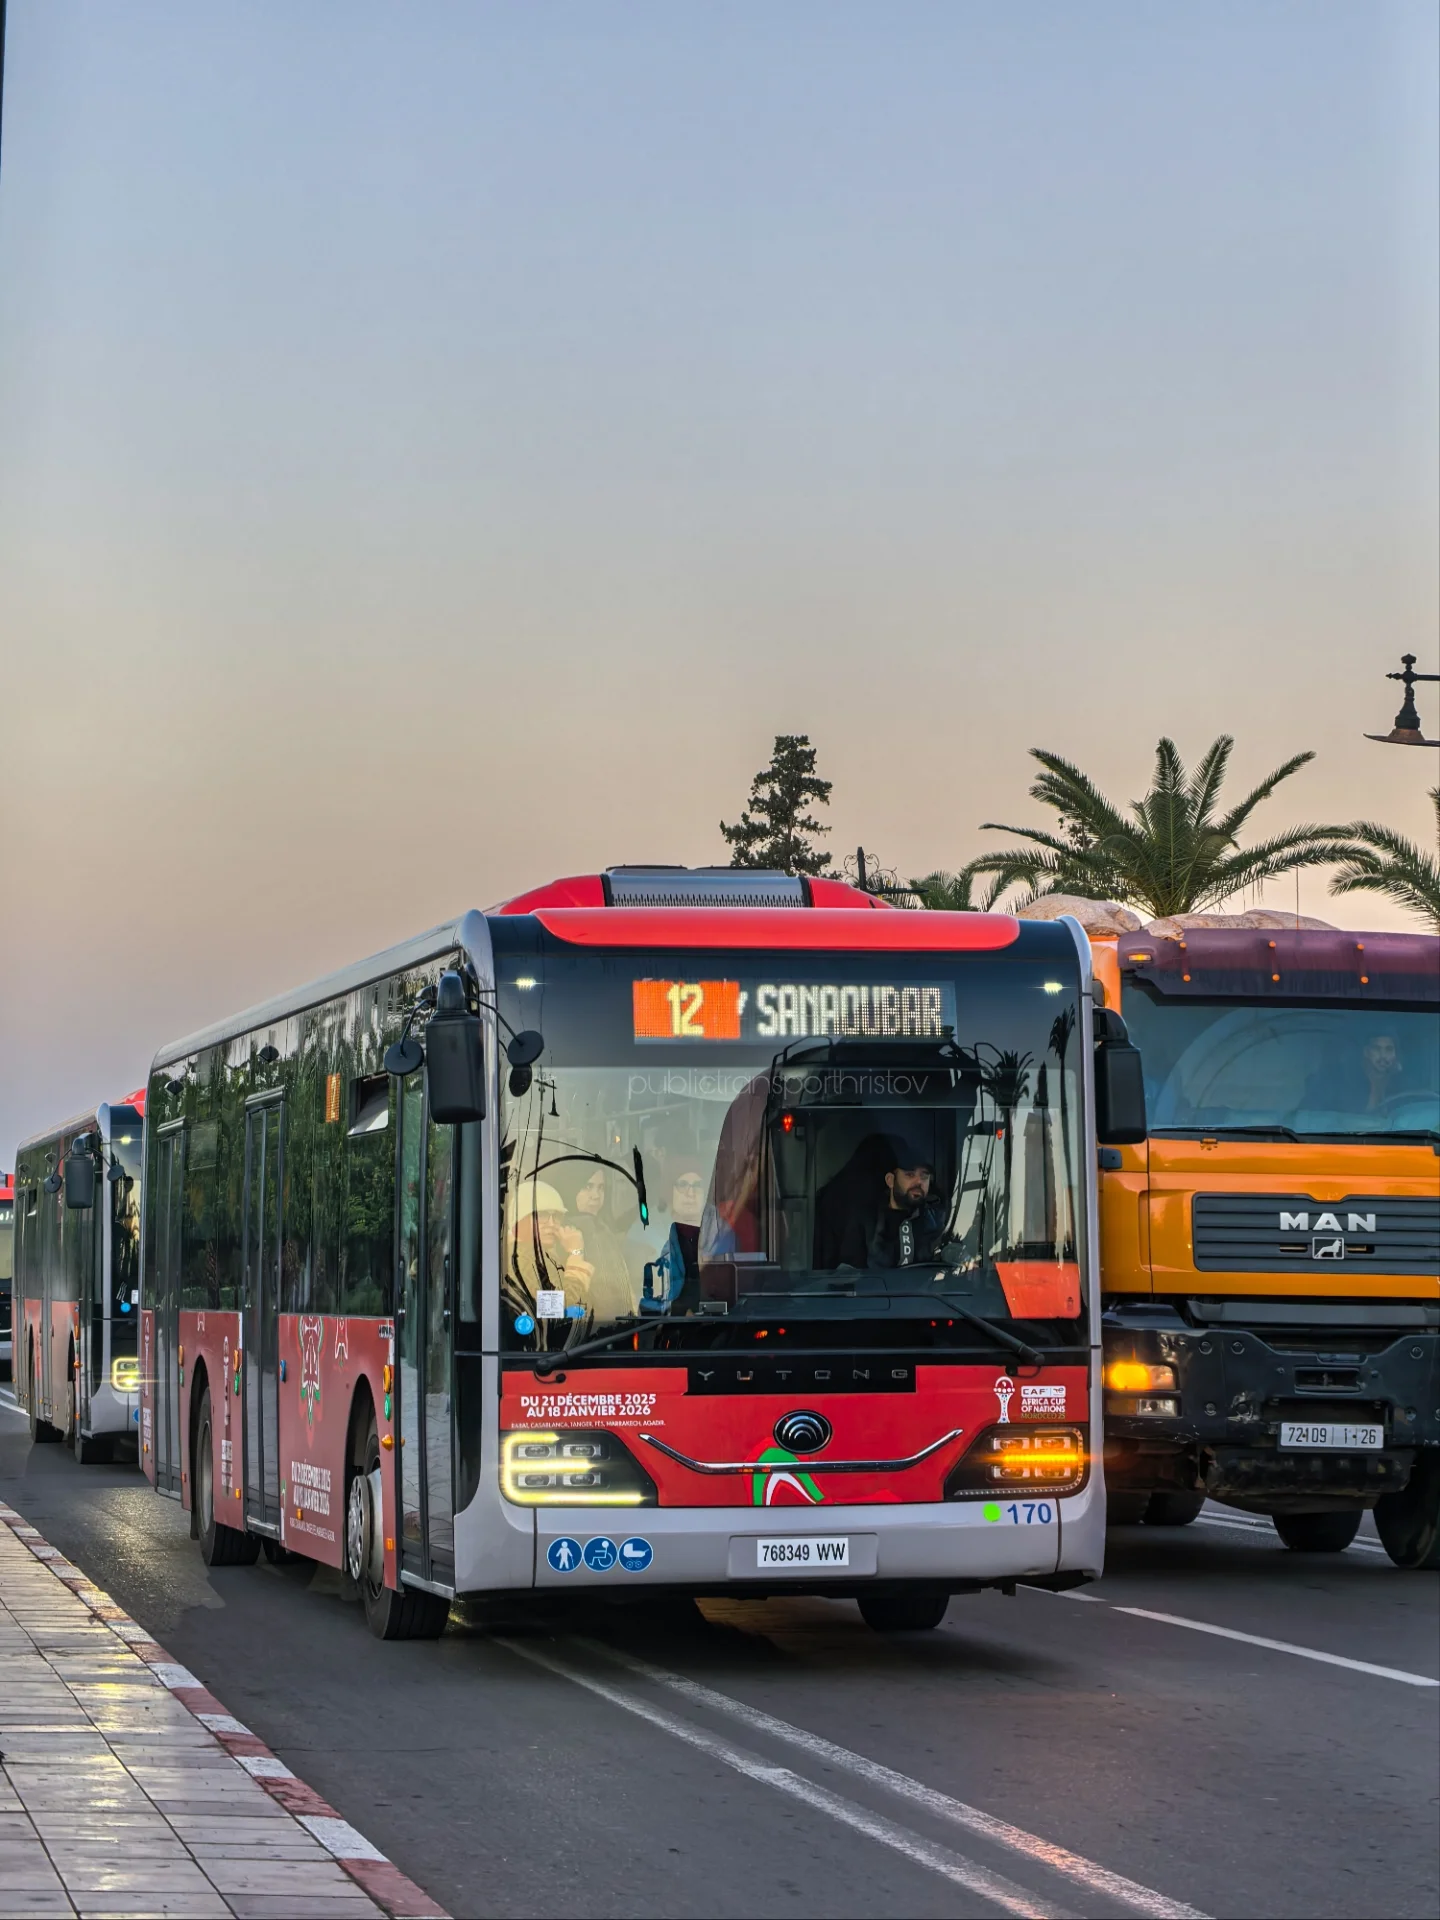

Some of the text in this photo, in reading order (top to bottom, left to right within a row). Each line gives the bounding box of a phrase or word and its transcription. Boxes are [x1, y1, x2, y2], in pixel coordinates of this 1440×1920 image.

[666, 984, 704, 1036] 12
[1279, 1212, 1376, 1232] MAN
[698, 1369, 908, 1381] YUTONG
[520, 1393, 656, 1407] DU 21 DÉCEMBRE 2025
[1022, 1398, 1066, 1406] AFRICA CUP
[526, 1404, 651, 1418] AU 18 JANVIER 2026
[1021, 1405, 1066, 1413] OF NATIONS
[1288, 1427, 1327, 1443] 72109
[1360, 1429, 1376, 1445] 26
[1007, 1503, 1052, 1525] 170
[762, 1543, 845, 1562] 768349 WW
